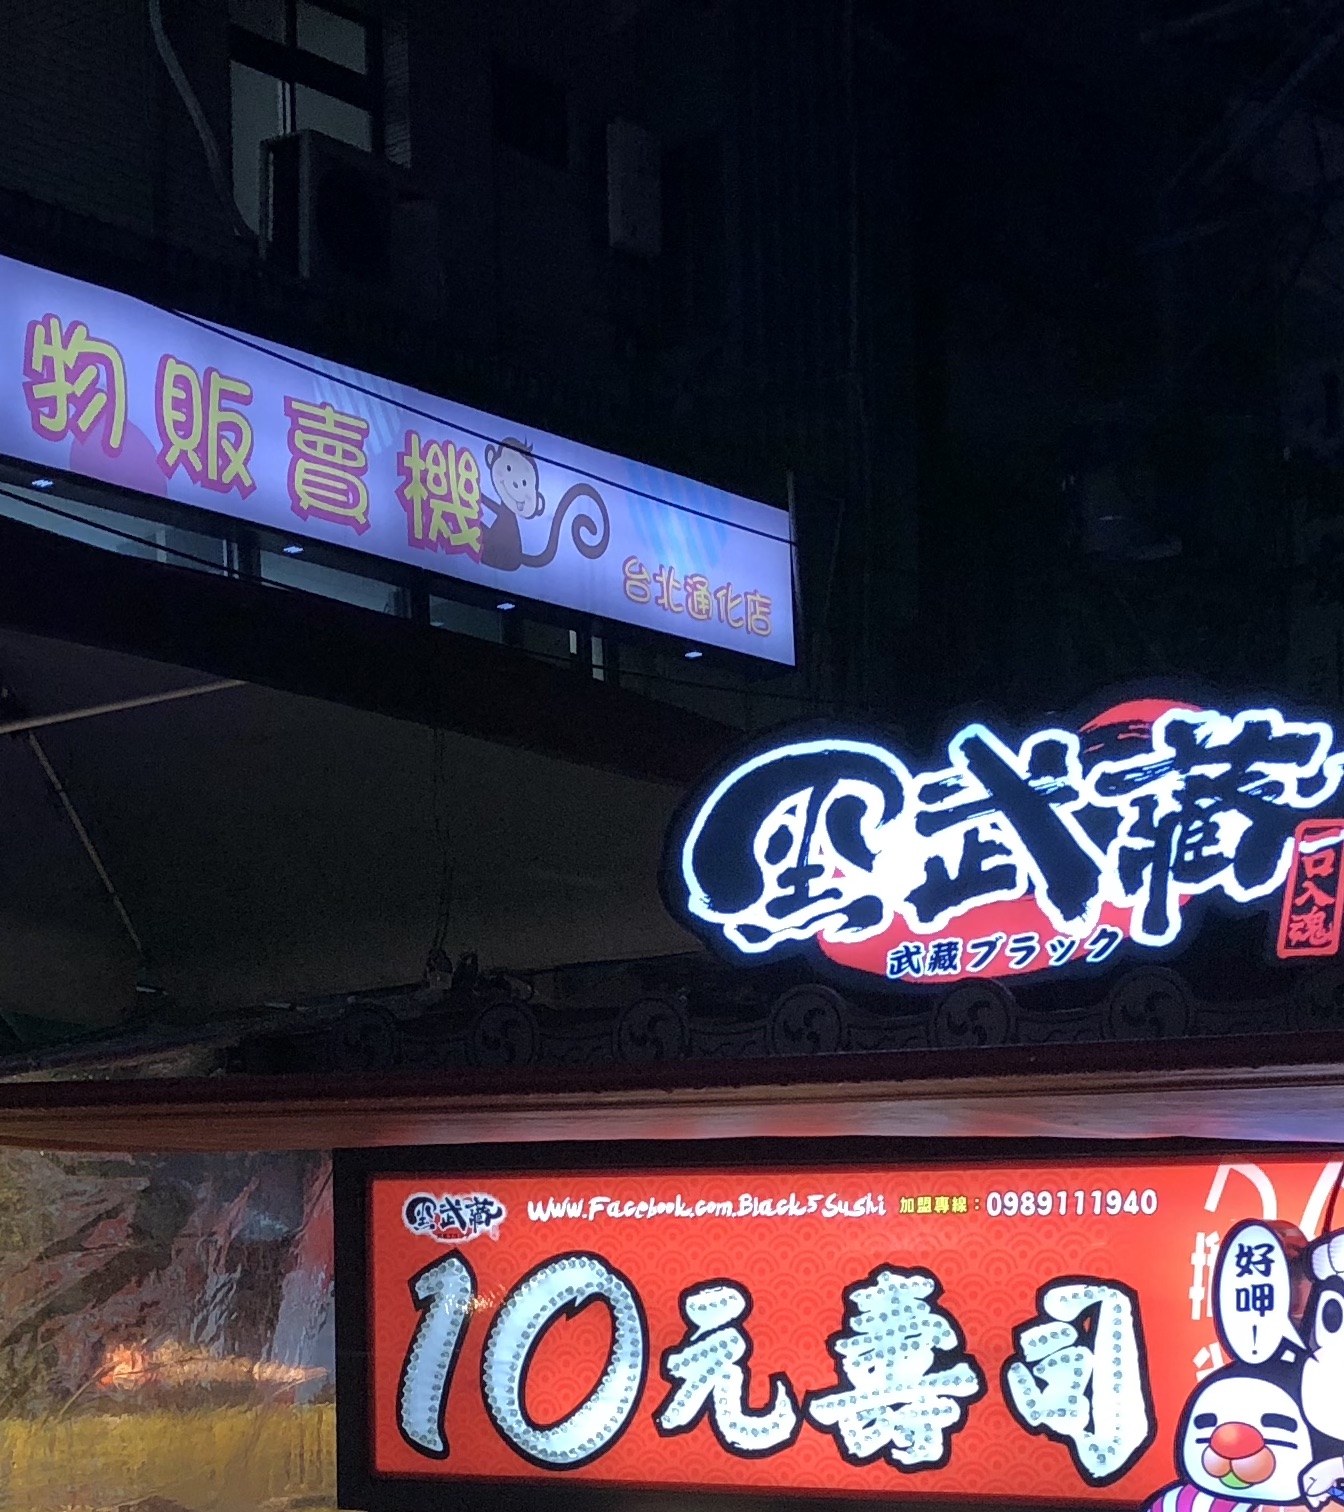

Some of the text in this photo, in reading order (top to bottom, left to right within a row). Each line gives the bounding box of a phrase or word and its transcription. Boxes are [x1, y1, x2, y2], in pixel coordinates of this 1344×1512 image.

[623, 556, 774, 636] 台北通化店
[987, 1188, 1158, 1217] 0989111940
[397, 1249, 1156, 1486] 10元壽司
